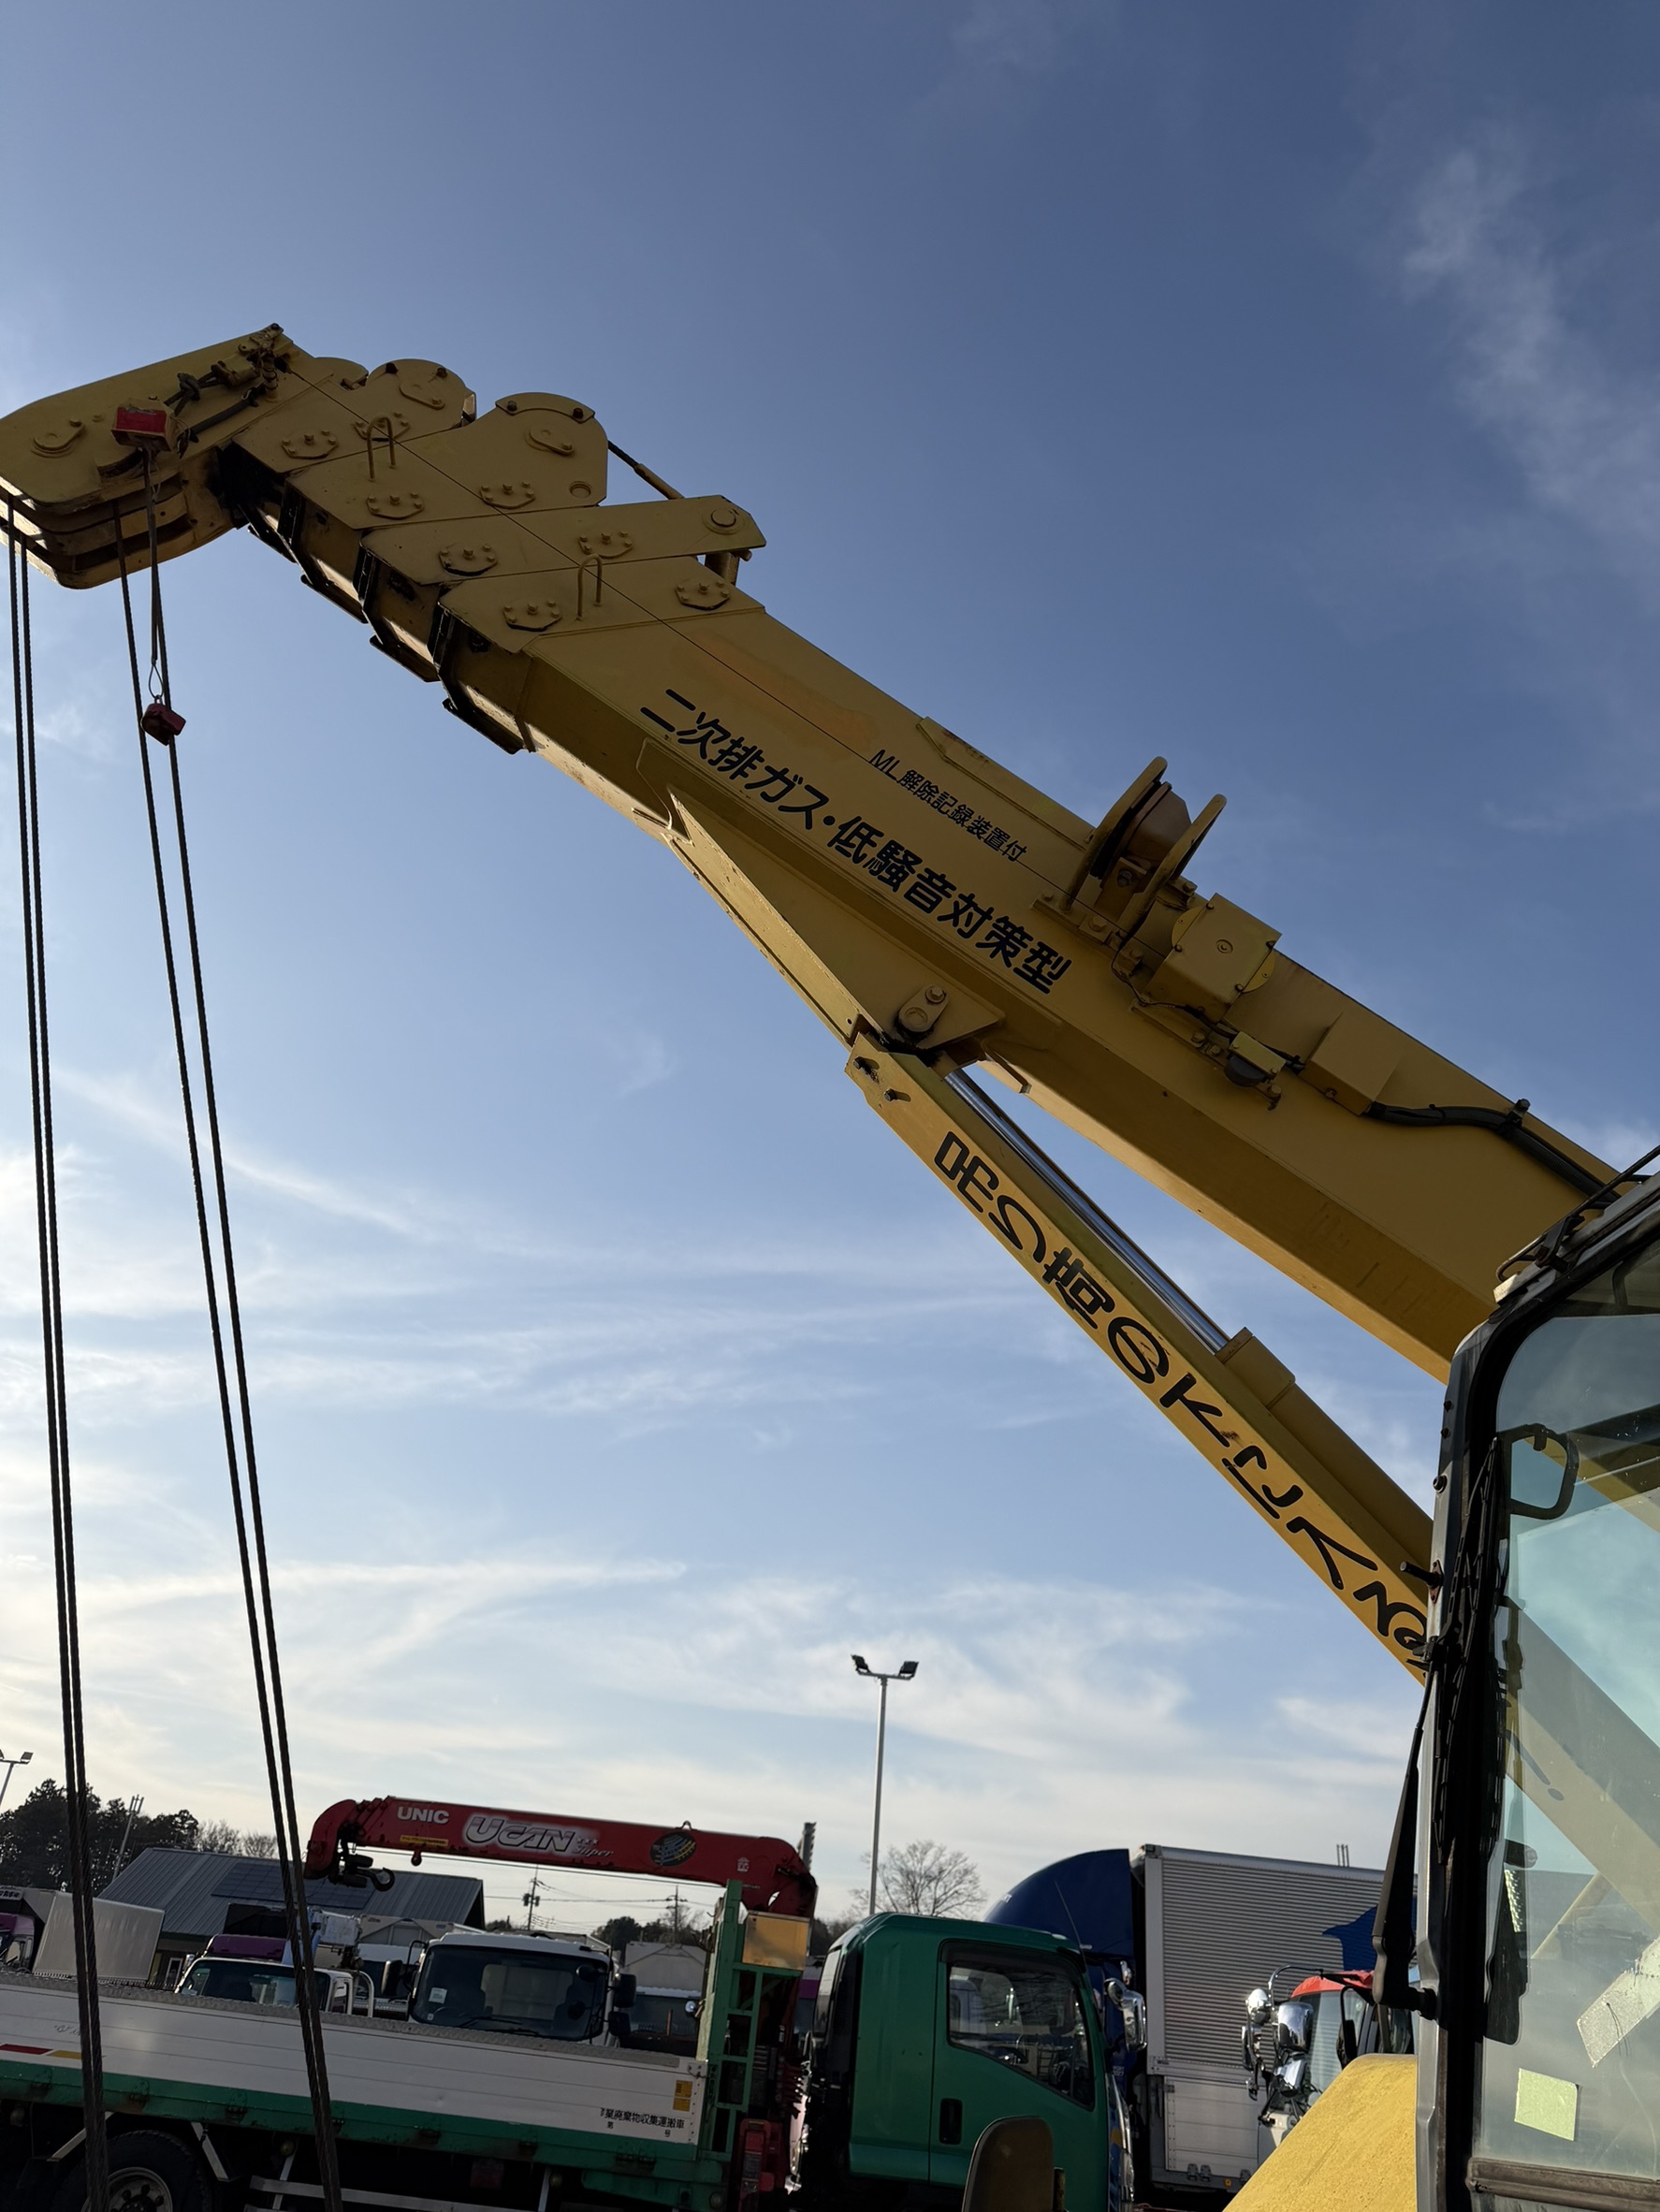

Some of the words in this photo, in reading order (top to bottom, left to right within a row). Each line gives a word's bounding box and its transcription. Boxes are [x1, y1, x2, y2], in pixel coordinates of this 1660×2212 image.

[869, 749, 1027, 862] ML解除記録装置付
[640, 689, 1072, 995] 二次排ガス・低騒音対策型
[397, 1806, 450, 1825] UNIC
[573, 1845, 615, 1857] Super
